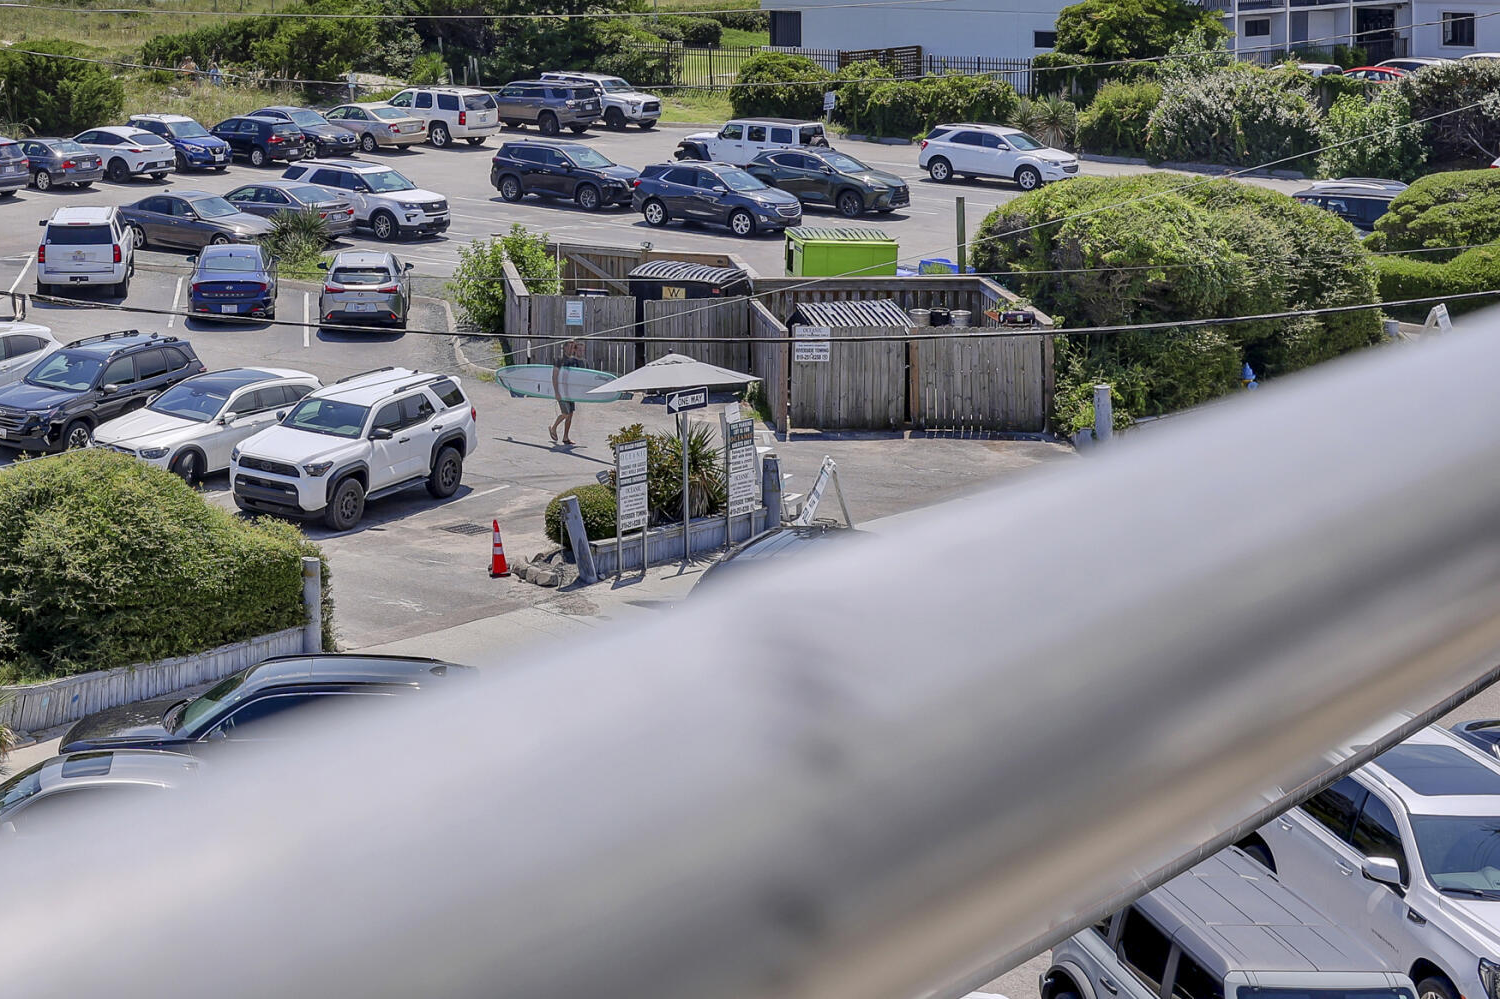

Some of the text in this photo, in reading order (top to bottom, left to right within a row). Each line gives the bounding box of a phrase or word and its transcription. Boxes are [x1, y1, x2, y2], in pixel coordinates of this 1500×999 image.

[668, 288, 680, 297] W
[678, 394, 702, 406] ONE WAY
